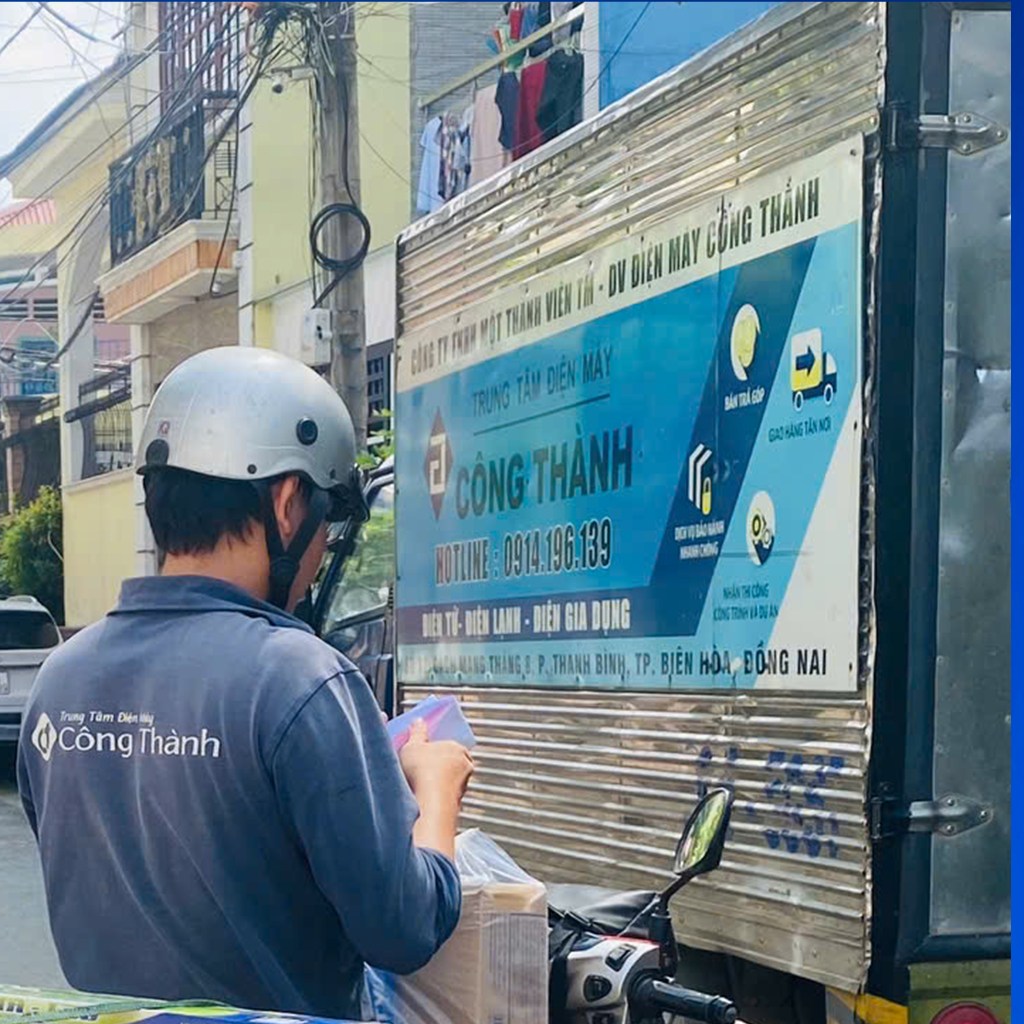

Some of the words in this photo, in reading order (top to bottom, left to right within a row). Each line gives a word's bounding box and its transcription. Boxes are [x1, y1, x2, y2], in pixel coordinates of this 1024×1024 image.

[546, 281, 572, 323] VIÊN
[608, 259, 626, 298] DV
[631, 241, 663, 289] ĐIỆN
[473, 381, 511, 418] TRUNG
[516, 366, 542, 399] TÂM
[547, 355, 576, 398] ĐIỆN
[582, 344, 614, 385] MÁY
[455, 451, 525, 520] CÔNG
[532, 423, 633, 505] THÀNH
[435, 537, 490, 586] HOTLINE
[504, 516, 613, 578] 0914.196.139
[533, 600, 561, 638] ĐIỆN
[565, 601, 588, 631] GIA
[592, 598, 631, 636] DỤNG
[661, 645, 693, 675] BIÊN
[743, 640, 789, 676] ĐỒNG
[797, 648, 828, 676] NAI
[58, 726, 133, 758] Công
[139, 727, 221, 758] Thành
[59, 711, 85, 725] Trung
[89, 711, 114, 723] Tâm
